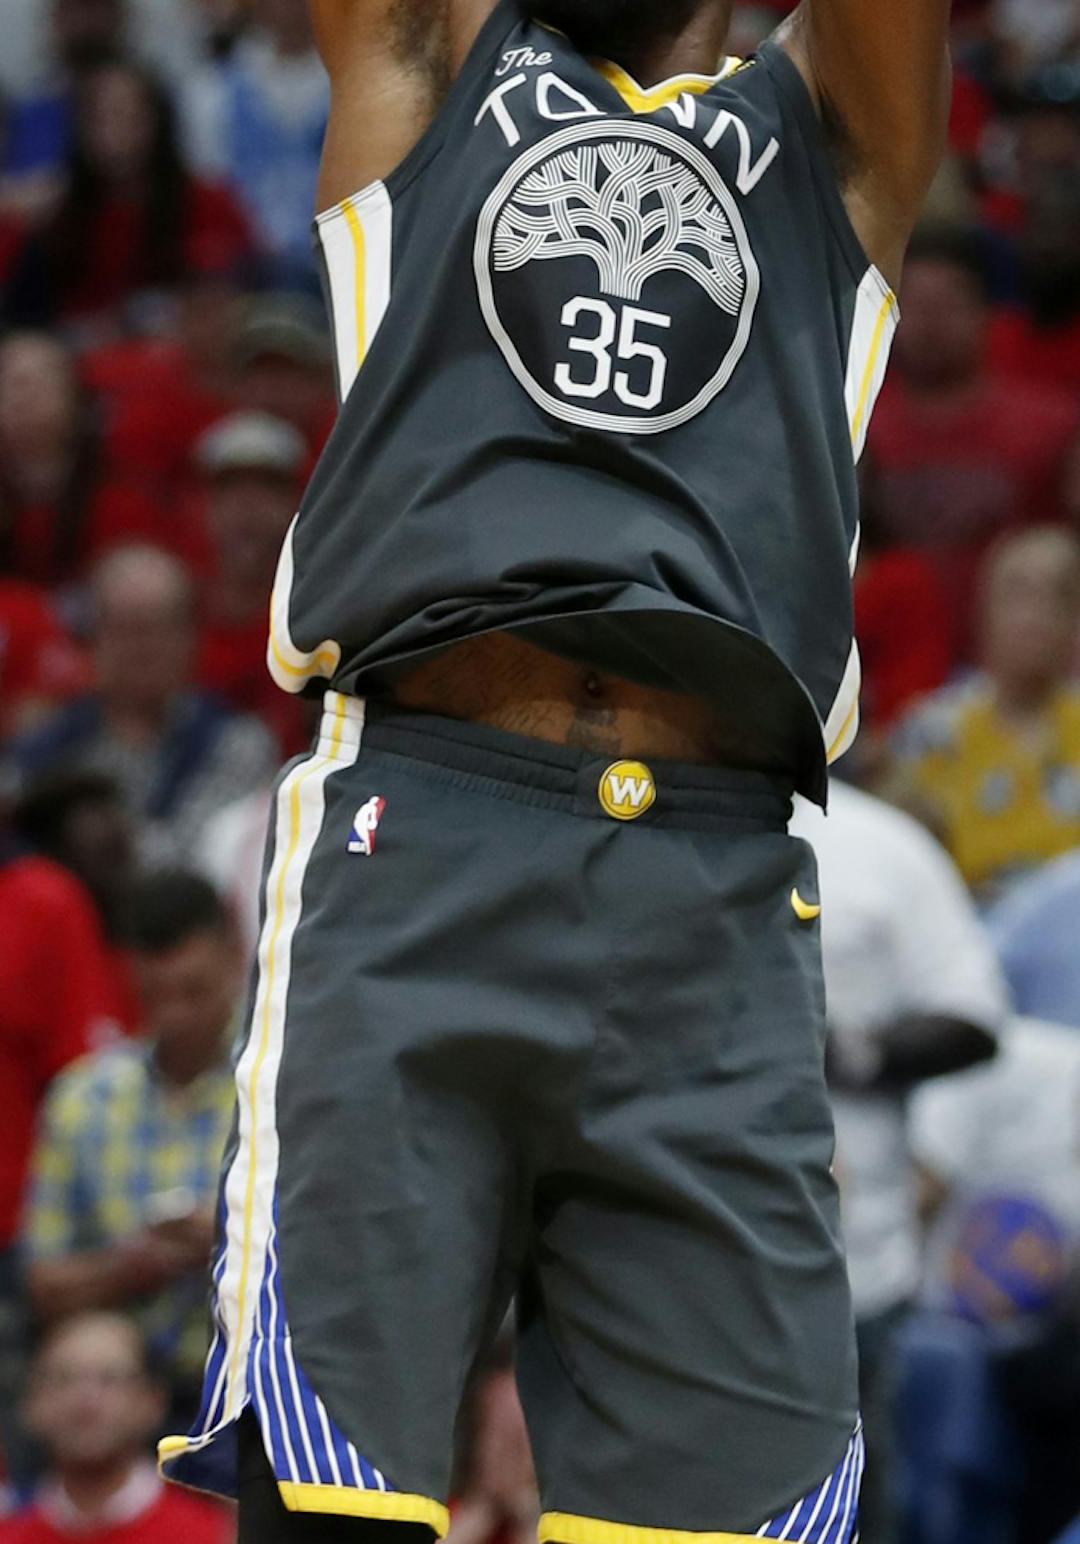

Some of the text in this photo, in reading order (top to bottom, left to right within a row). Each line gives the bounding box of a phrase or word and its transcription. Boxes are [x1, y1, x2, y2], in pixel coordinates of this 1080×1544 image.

[495, 46, 553, 77] The
[554, 295, 672, 411] 35
[607, 774, 650, 807] W
